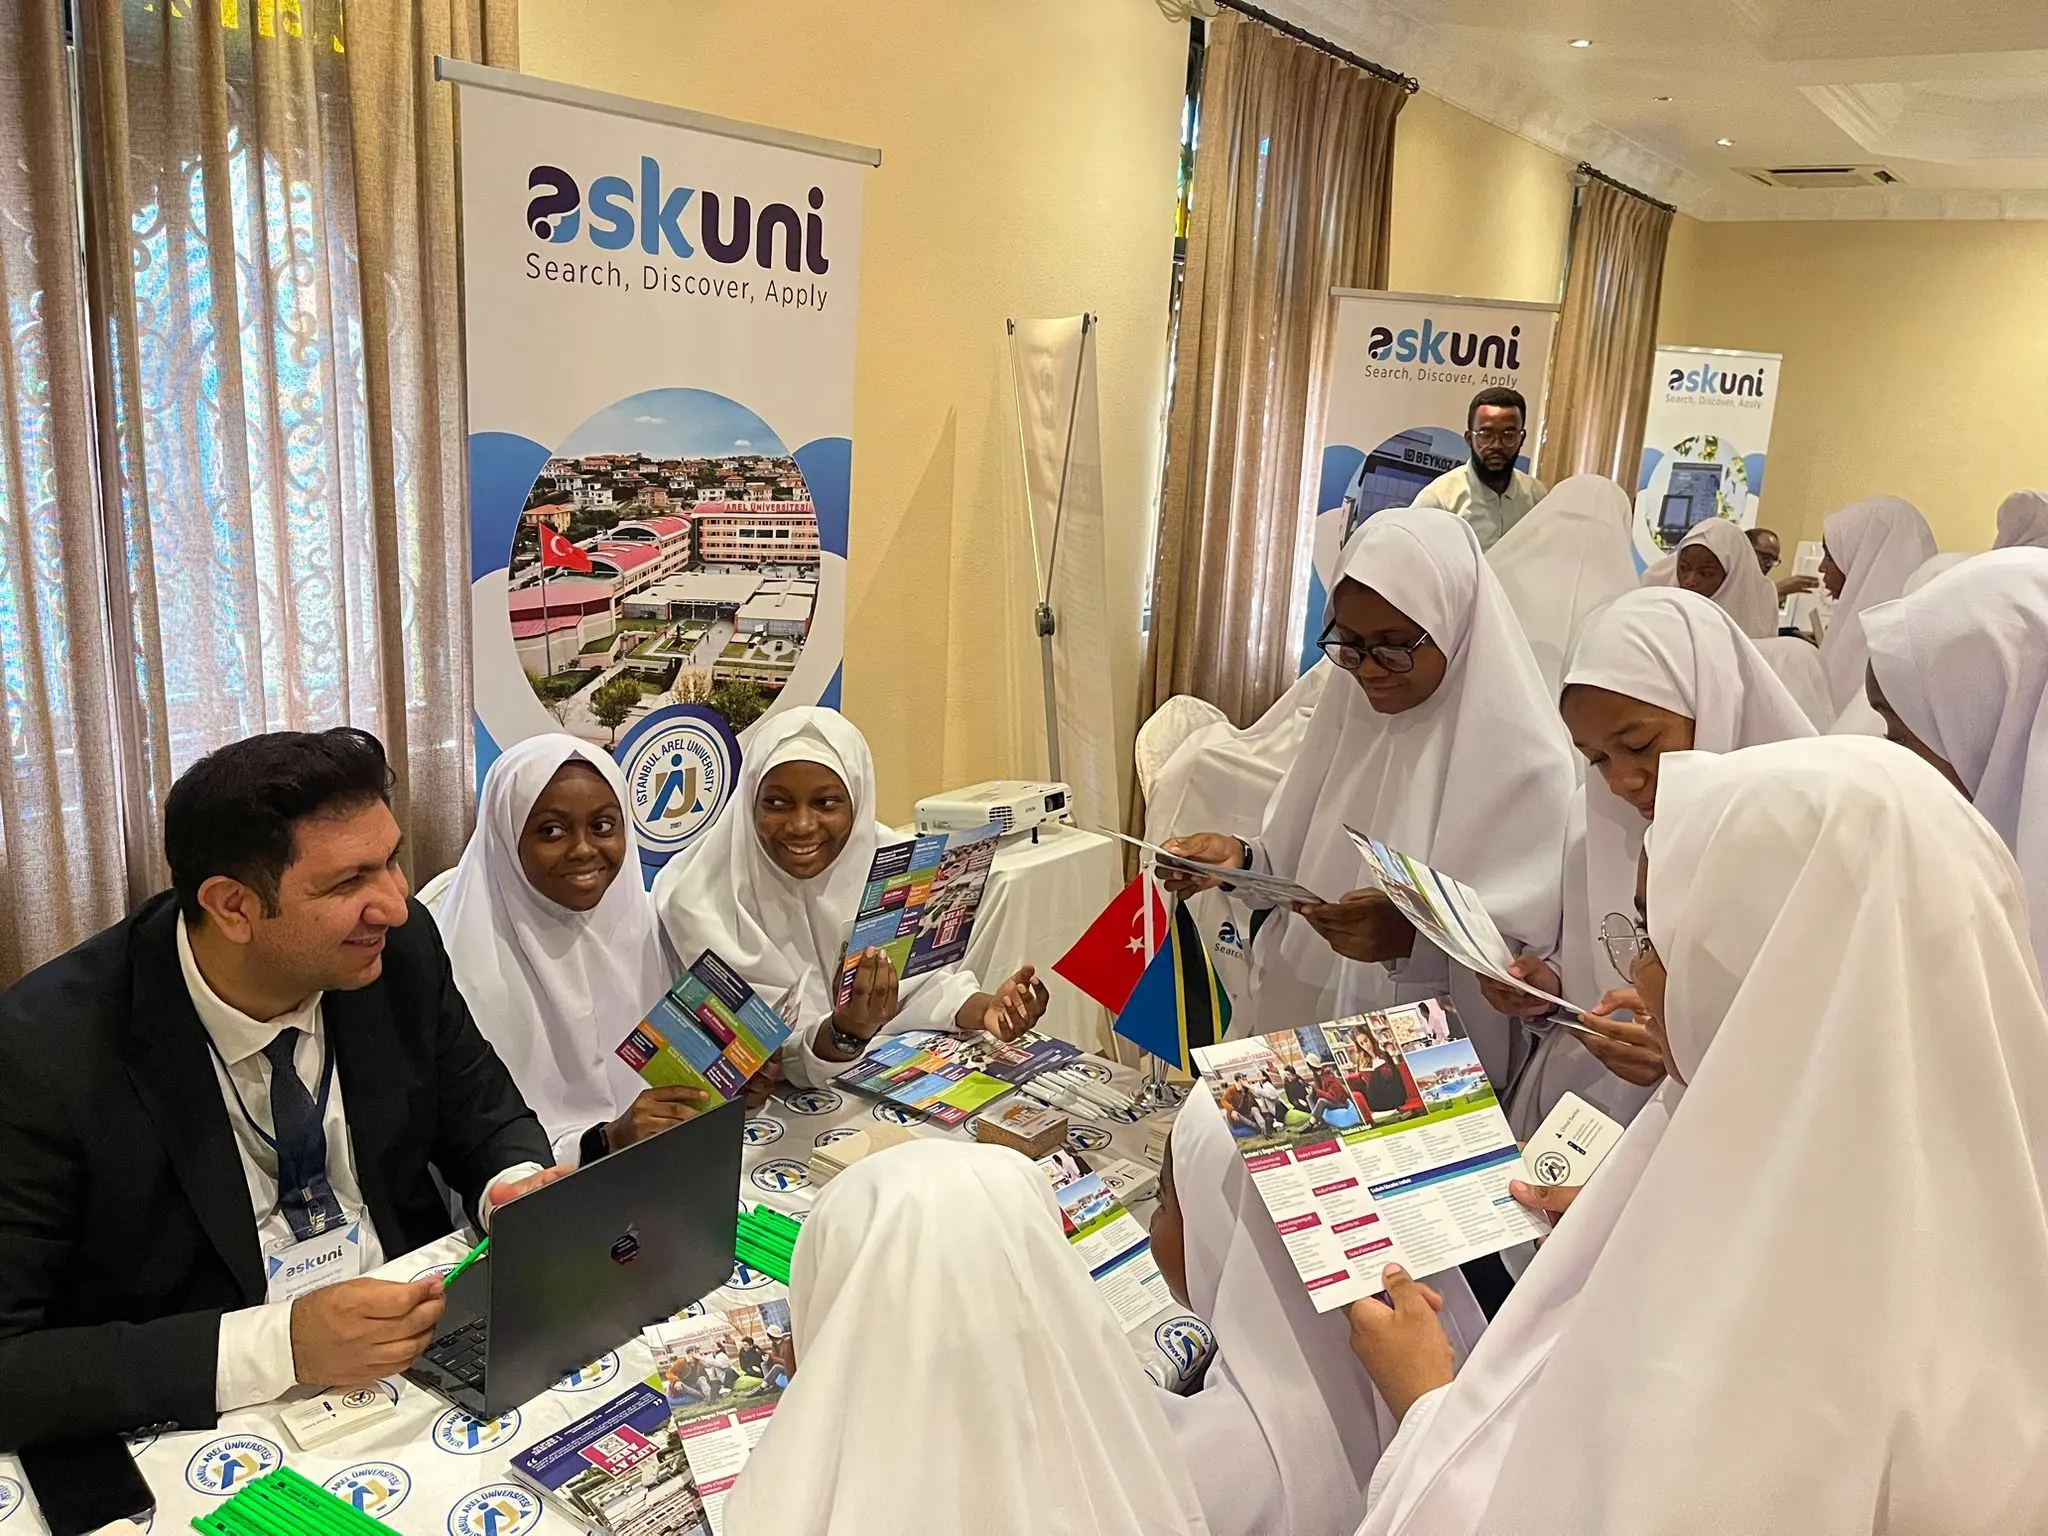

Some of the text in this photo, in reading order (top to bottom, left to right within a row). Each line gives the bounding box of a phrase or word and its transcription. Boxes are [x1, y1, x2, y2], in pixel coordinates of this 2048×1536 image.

[526, 155, 829, 275] askuni
[526, 252, 828, 312] Search, Discover, Apply
[1368, 318, 1521, 370] askuni
[1364, 365, 1518, 388] Search, Discover, Apply
[1668, 363, 1764, 397] askuni
[1415, 451, 1451, 471] BEYKOZ
[726, 503, 748, 511] AREL
[661, 738, 686, 756] AREL
[687, 740, 714, 793] UNIVERSITY
[286, 1245, 343, 1277] askuni
[203, 1447, 222, 1462] AREL
[604, 1442, 638, 1464] AREL
[609, 1443, 657, 1474] LIFE AT
[462, 1498, 482, 1514] AREL
